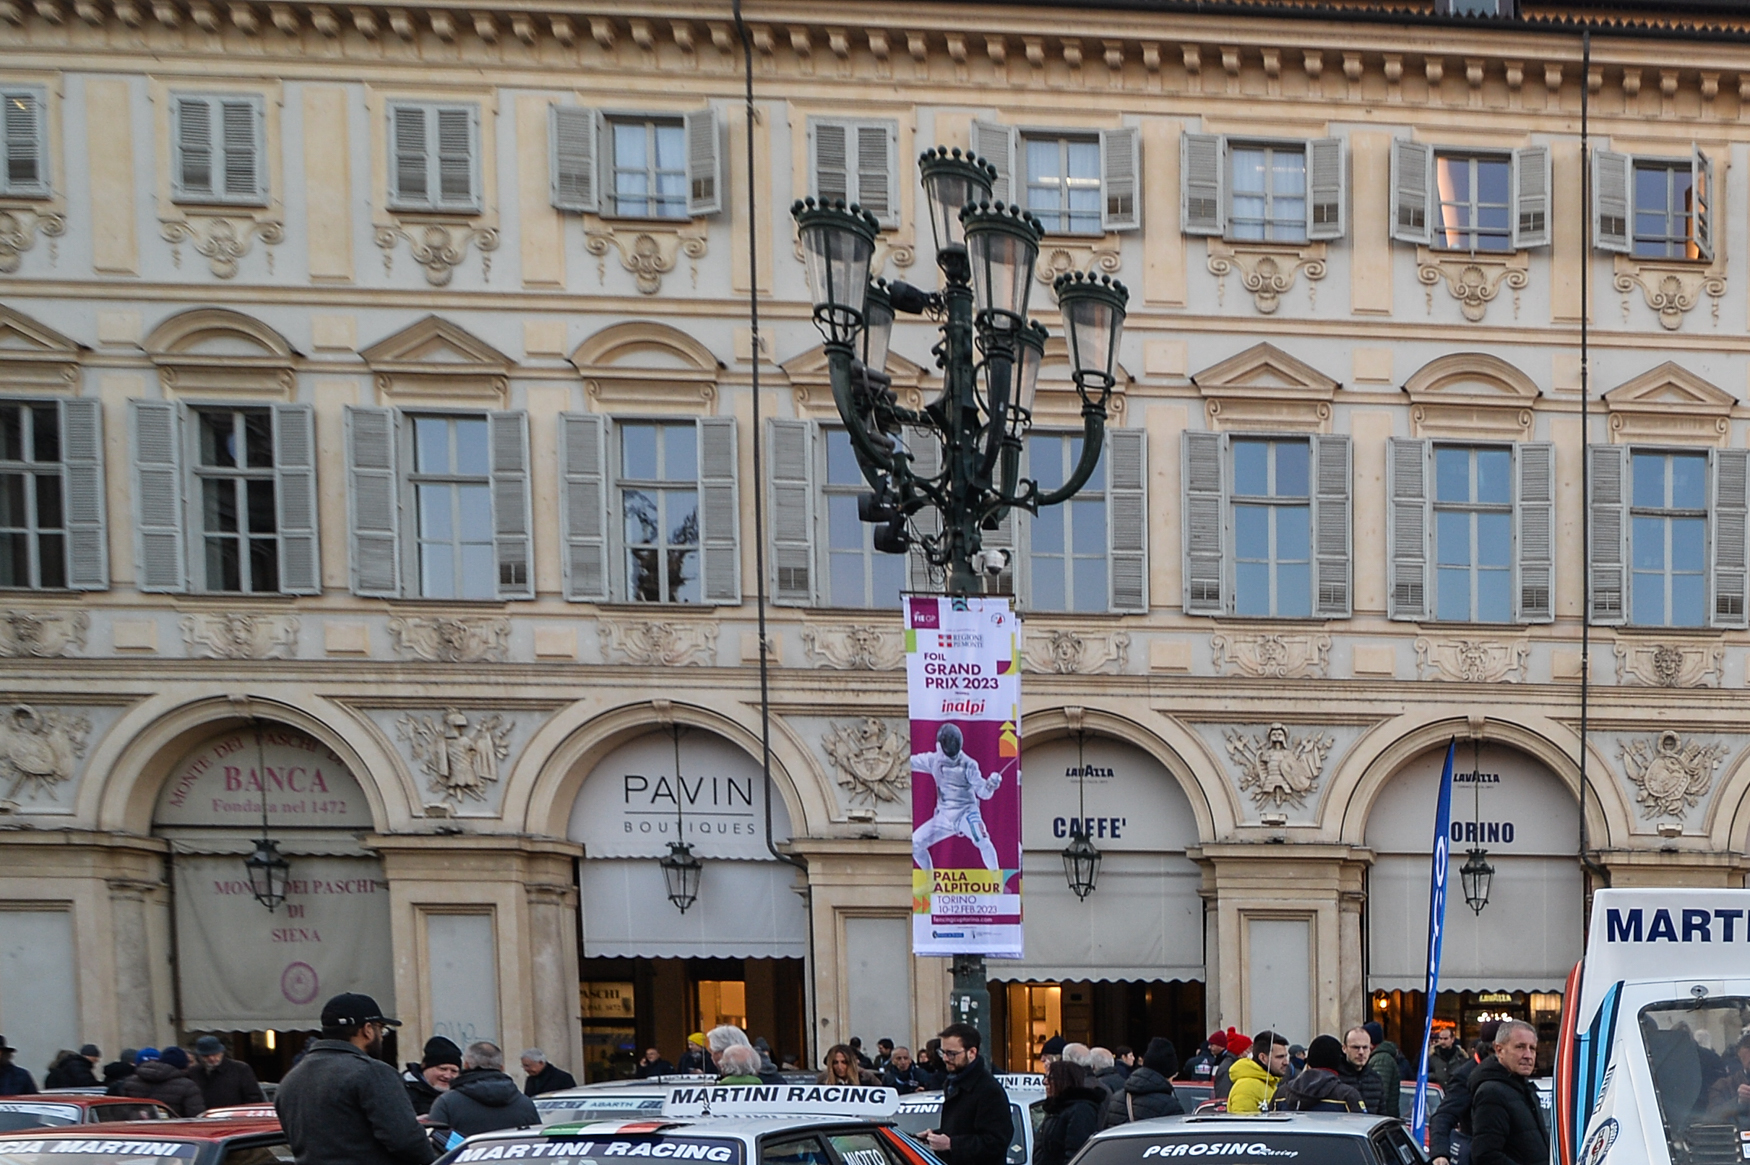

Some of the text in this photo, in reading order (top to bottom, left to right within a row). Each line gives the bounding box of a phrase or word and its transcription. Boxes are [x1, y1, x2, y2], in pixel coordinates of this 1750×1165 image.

[924, 652, 946, 660] FOIL
[924, 663, 981, 675] GRAND
[925, 677, 999, 689] PRIX 2023
[942, 699, 985, 715] inalpi
[1065, 764, 1115, 778] LAVAZZA
[1453, 771, 1500, 783] LAVAZZA
[170, 757, 214, 808] MONTE
[223, 766, 329, 793] BANCA
[624, 775, 752, 806] PAVIN
[282, 800, 347, 814] nel 1472
[624, 821, 755, 835] BOUTIQUES
[1450, 822, 1515, 844] ORINO
[933, 871, 967, 881] PALA
[313, 879, 376, 894] PASCHI
[933, 883, 1000, 893] ALPITOUR
[937, 895, 977, 904] TORINO
[288, 904, 305, 918] DI
[271, 928, 322, 942] SIENA
[670, 1087, 888, 1105] MARTINI RACING
[50, 1142, 181, 1156] MARTINI
[454, 1141, 732, 1163] MARTINI RACING
[1142, 1143, 1298, 1159] PEROSINO Racing
